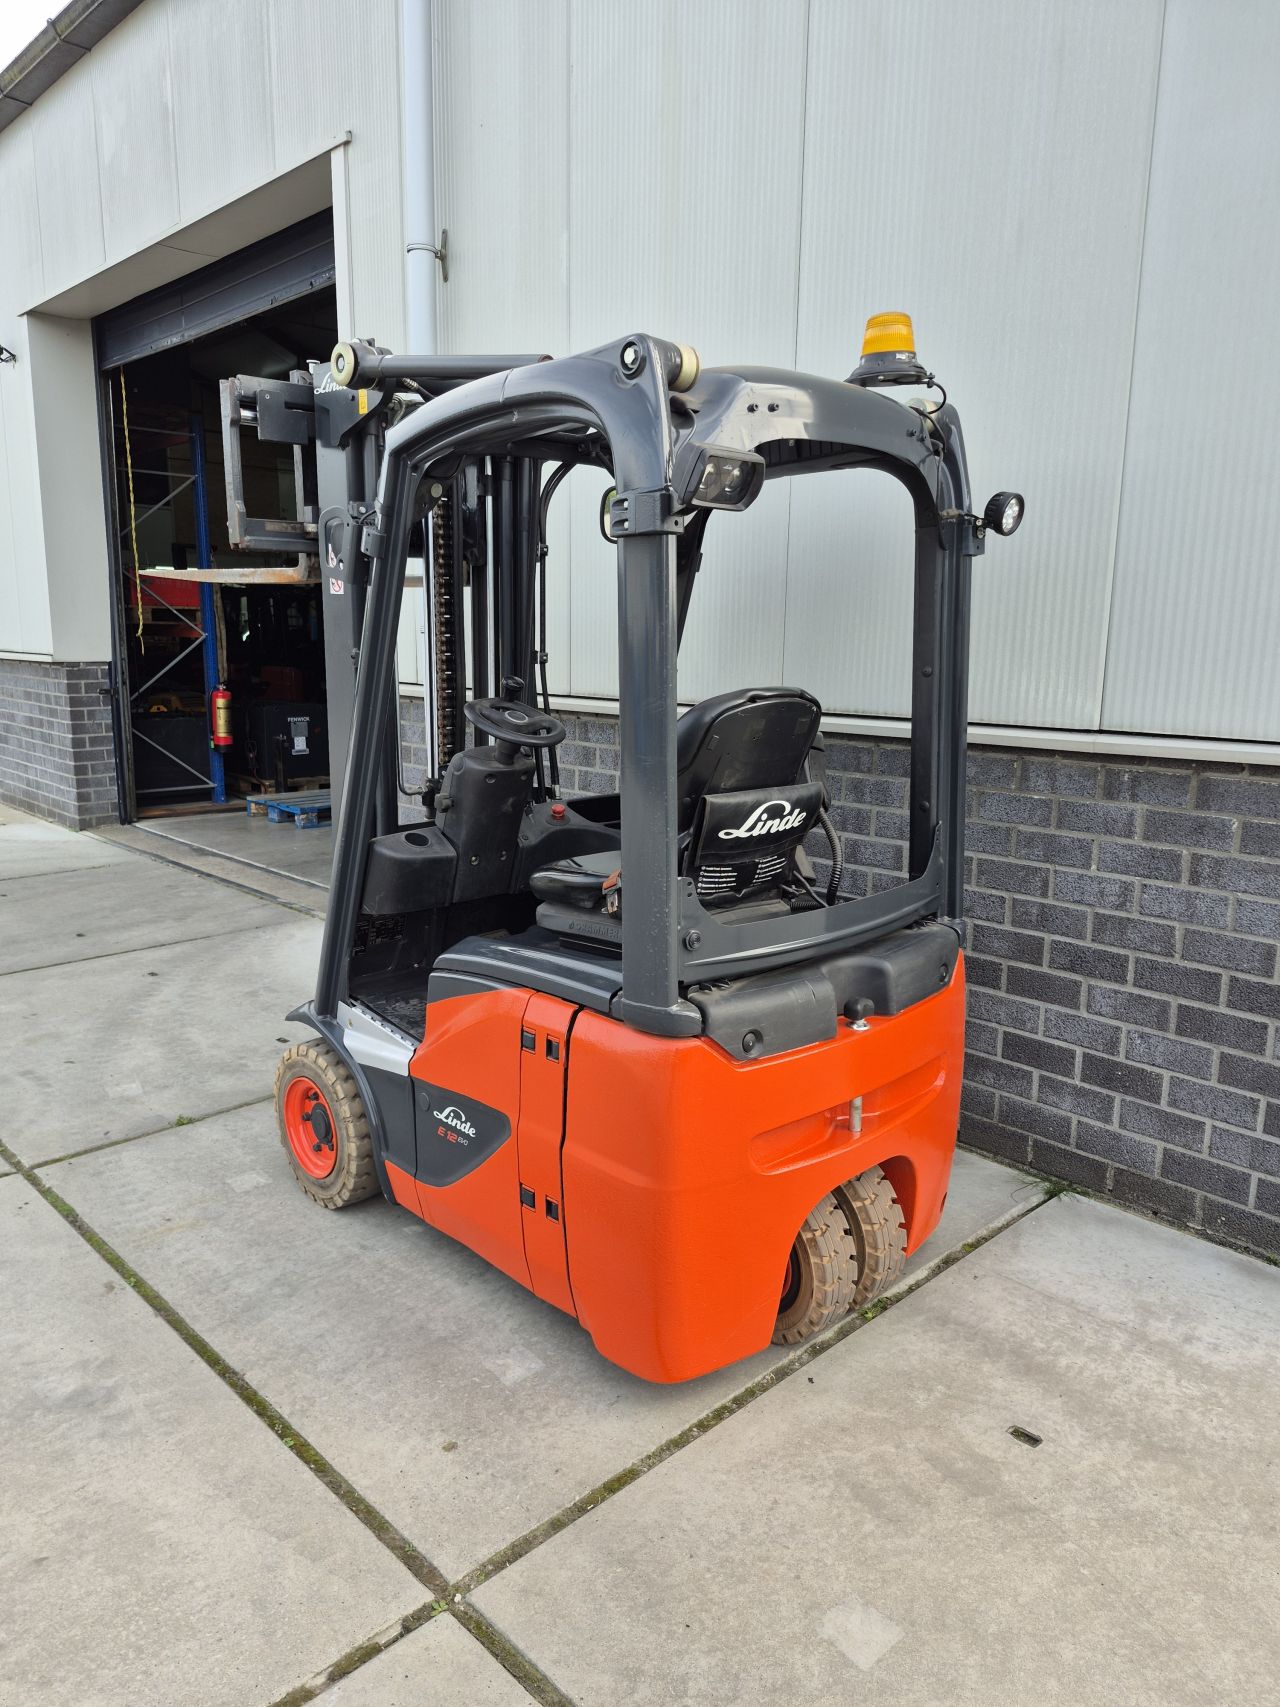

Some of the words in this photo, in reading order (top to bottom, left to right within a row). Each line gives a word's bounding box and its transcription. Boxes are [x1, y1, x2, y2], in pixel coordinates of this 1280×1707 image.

[718, 800, 807, 839] Linde
[433, 1106, 476, 1137] Linde
[437, 1126, 446, 1137] E
[447, 1131, 458, 1143] 12
